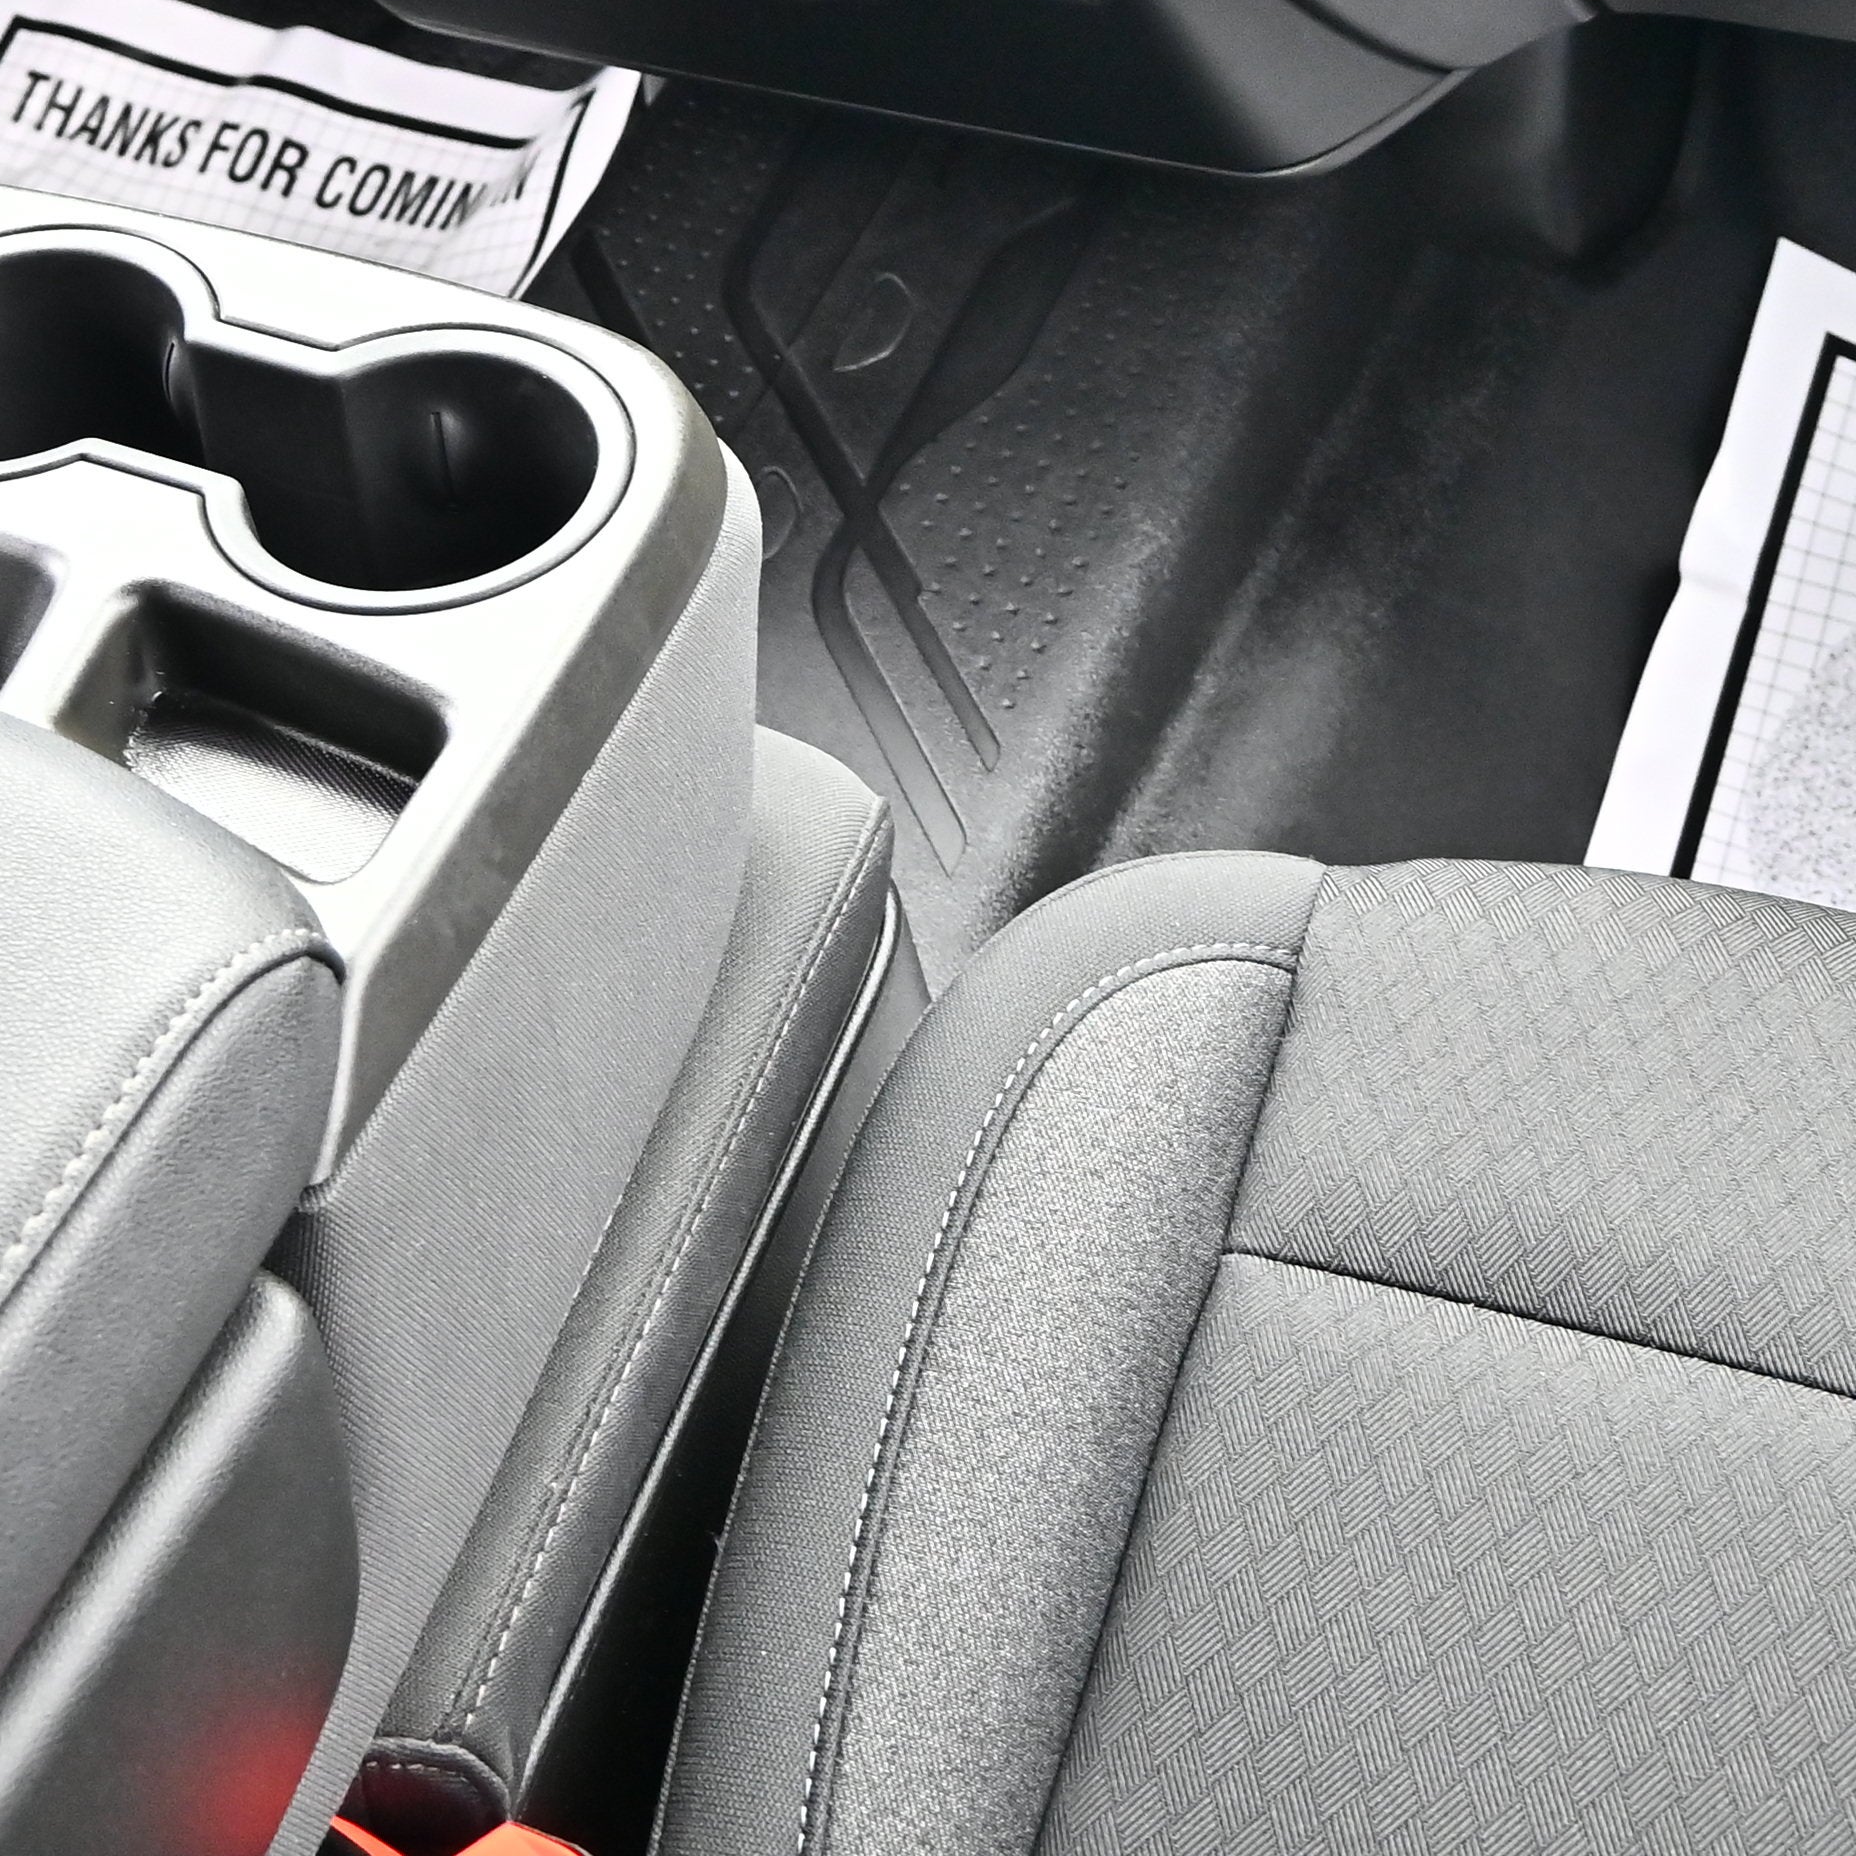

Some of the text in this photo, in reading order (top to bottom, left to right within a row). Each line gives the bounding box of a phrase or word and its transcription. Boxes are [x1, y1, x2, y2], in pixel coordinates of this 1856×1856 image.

[11, 71, 202, 168] THANKS
[199, 120, 310, 197] FOR
[316, 156, 488, 231] COMIN
